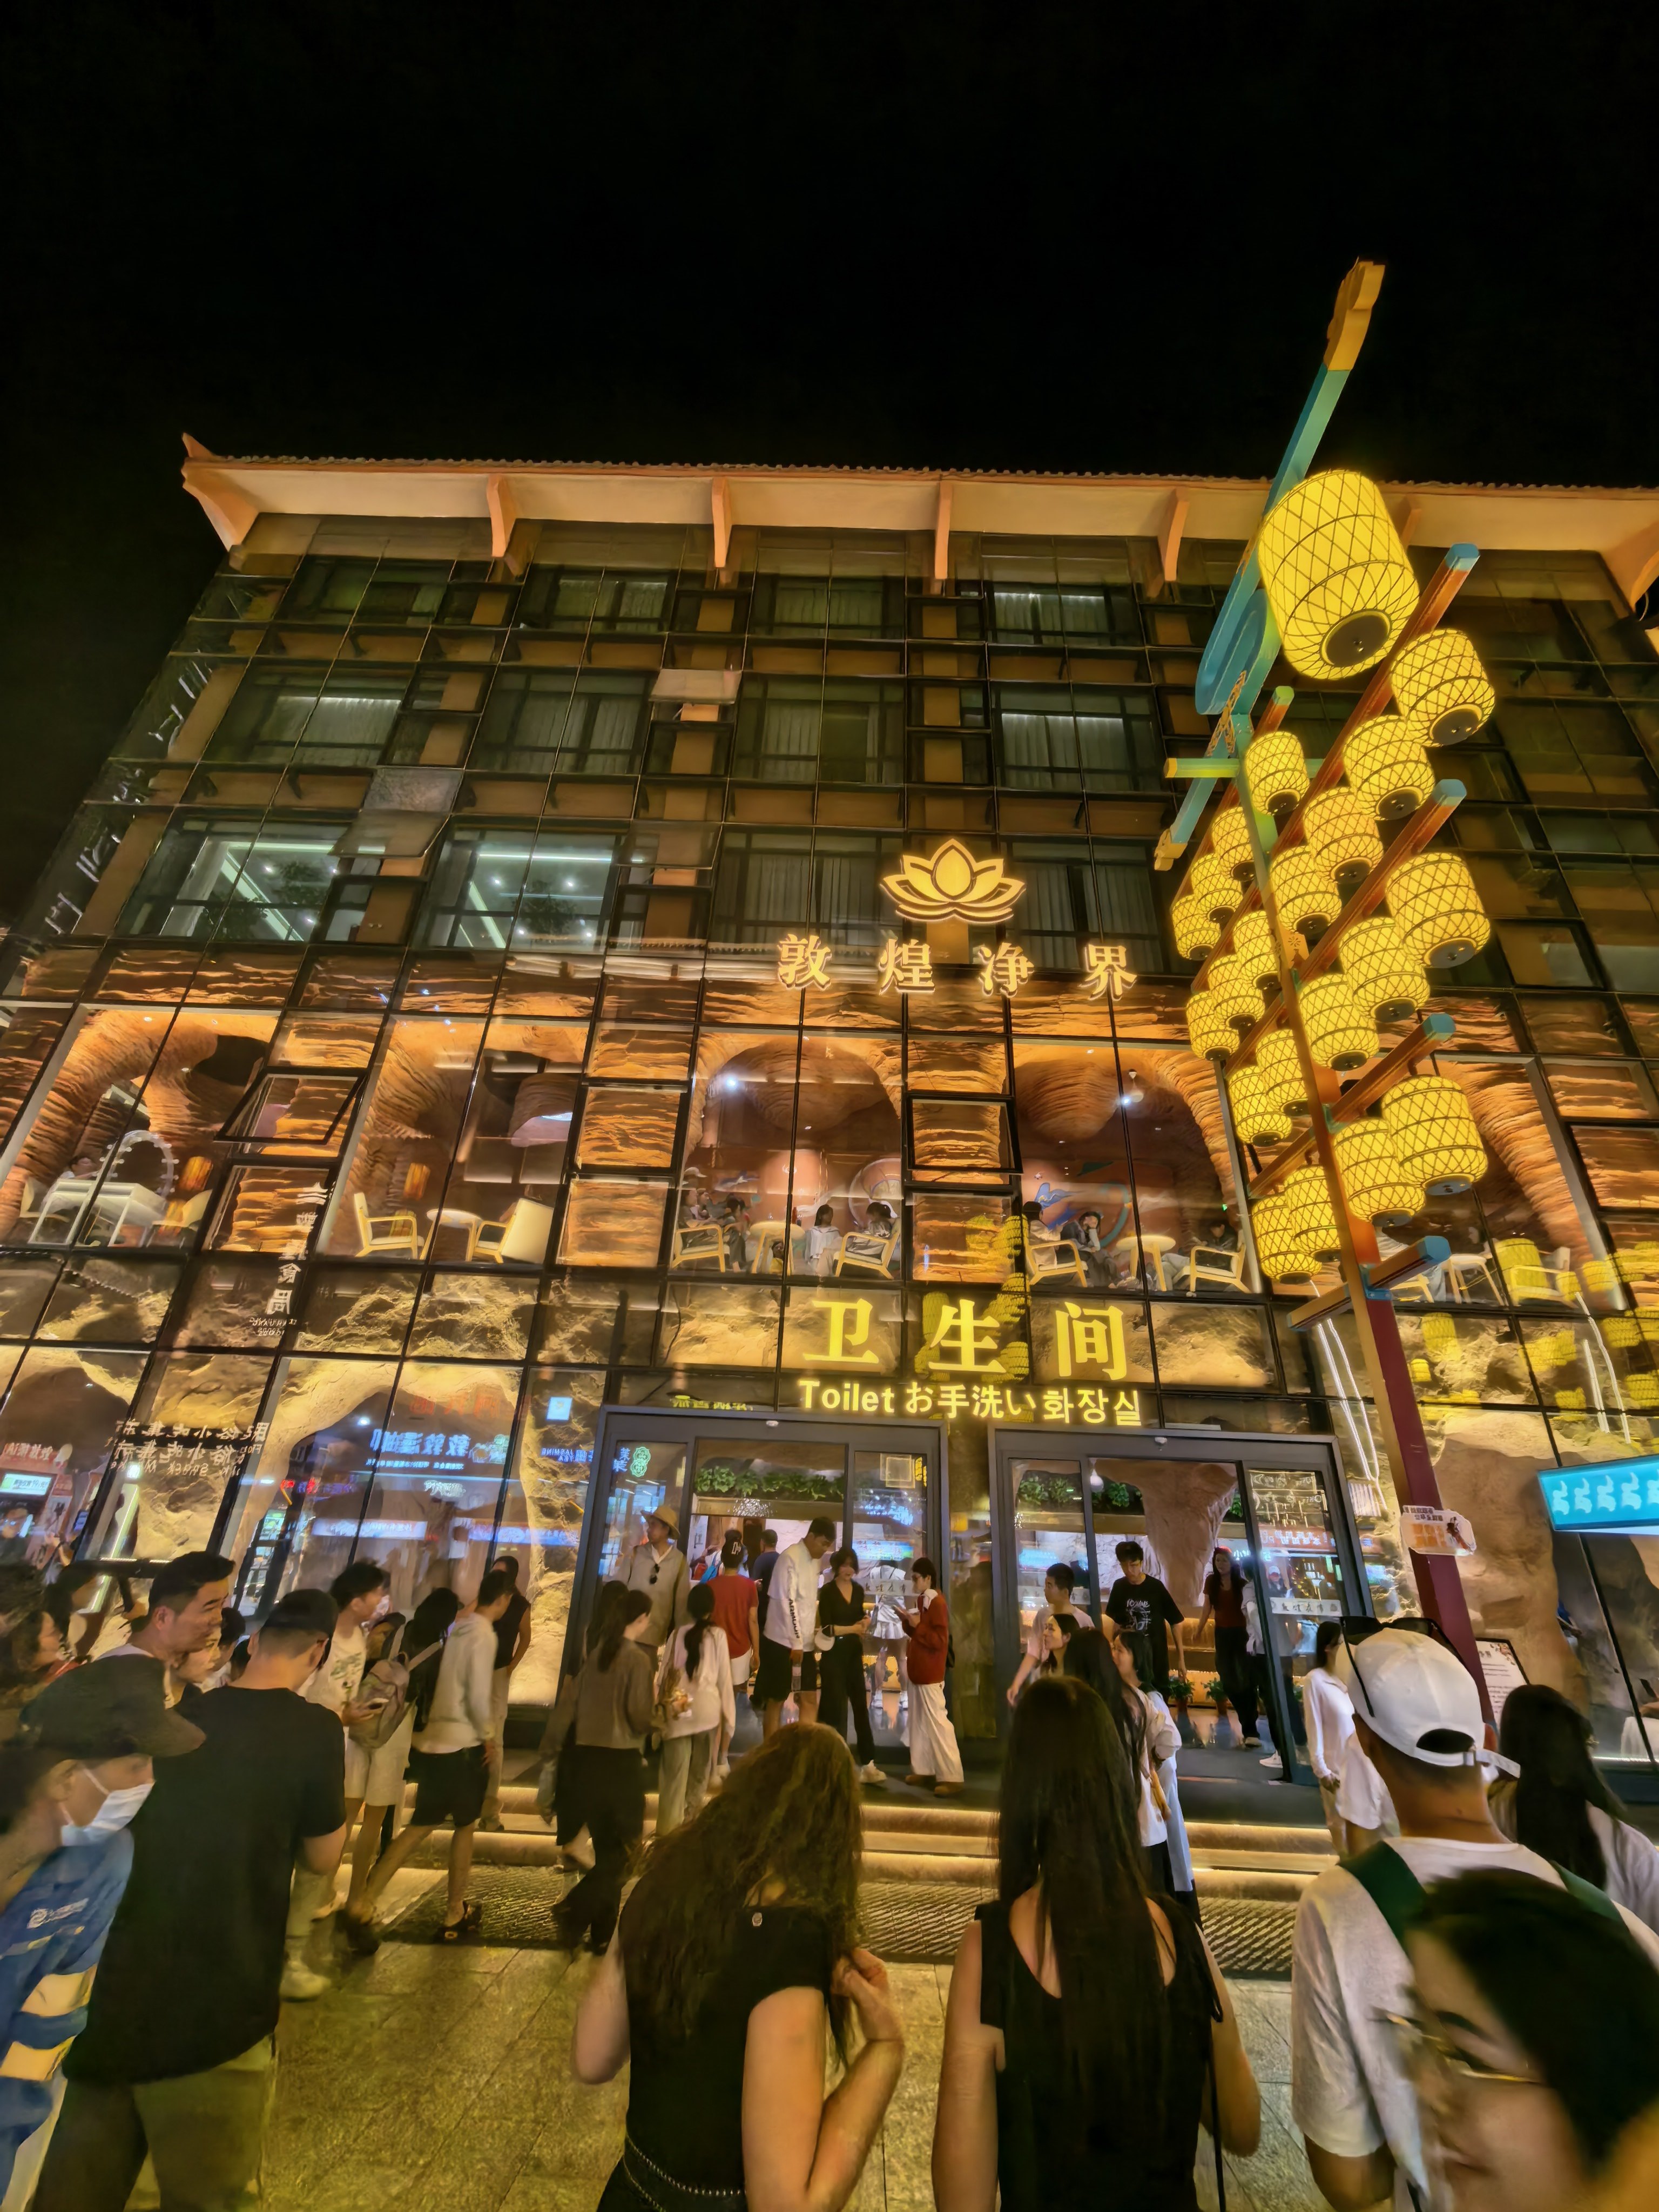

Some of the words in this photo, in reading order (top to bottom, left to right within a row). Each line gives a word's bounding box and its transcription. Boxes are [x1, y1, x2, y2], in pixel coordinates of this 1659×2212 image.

[778, 933, 1137, 1000] 敦煌净界
[803, 1299, 1129, 1380] 卫生间
[799, 1380, 895, 1413] Toilet
[906, 1381, 1036, 1419] お手洗い
[1043, 1388, 1141, 1426] 화장실
